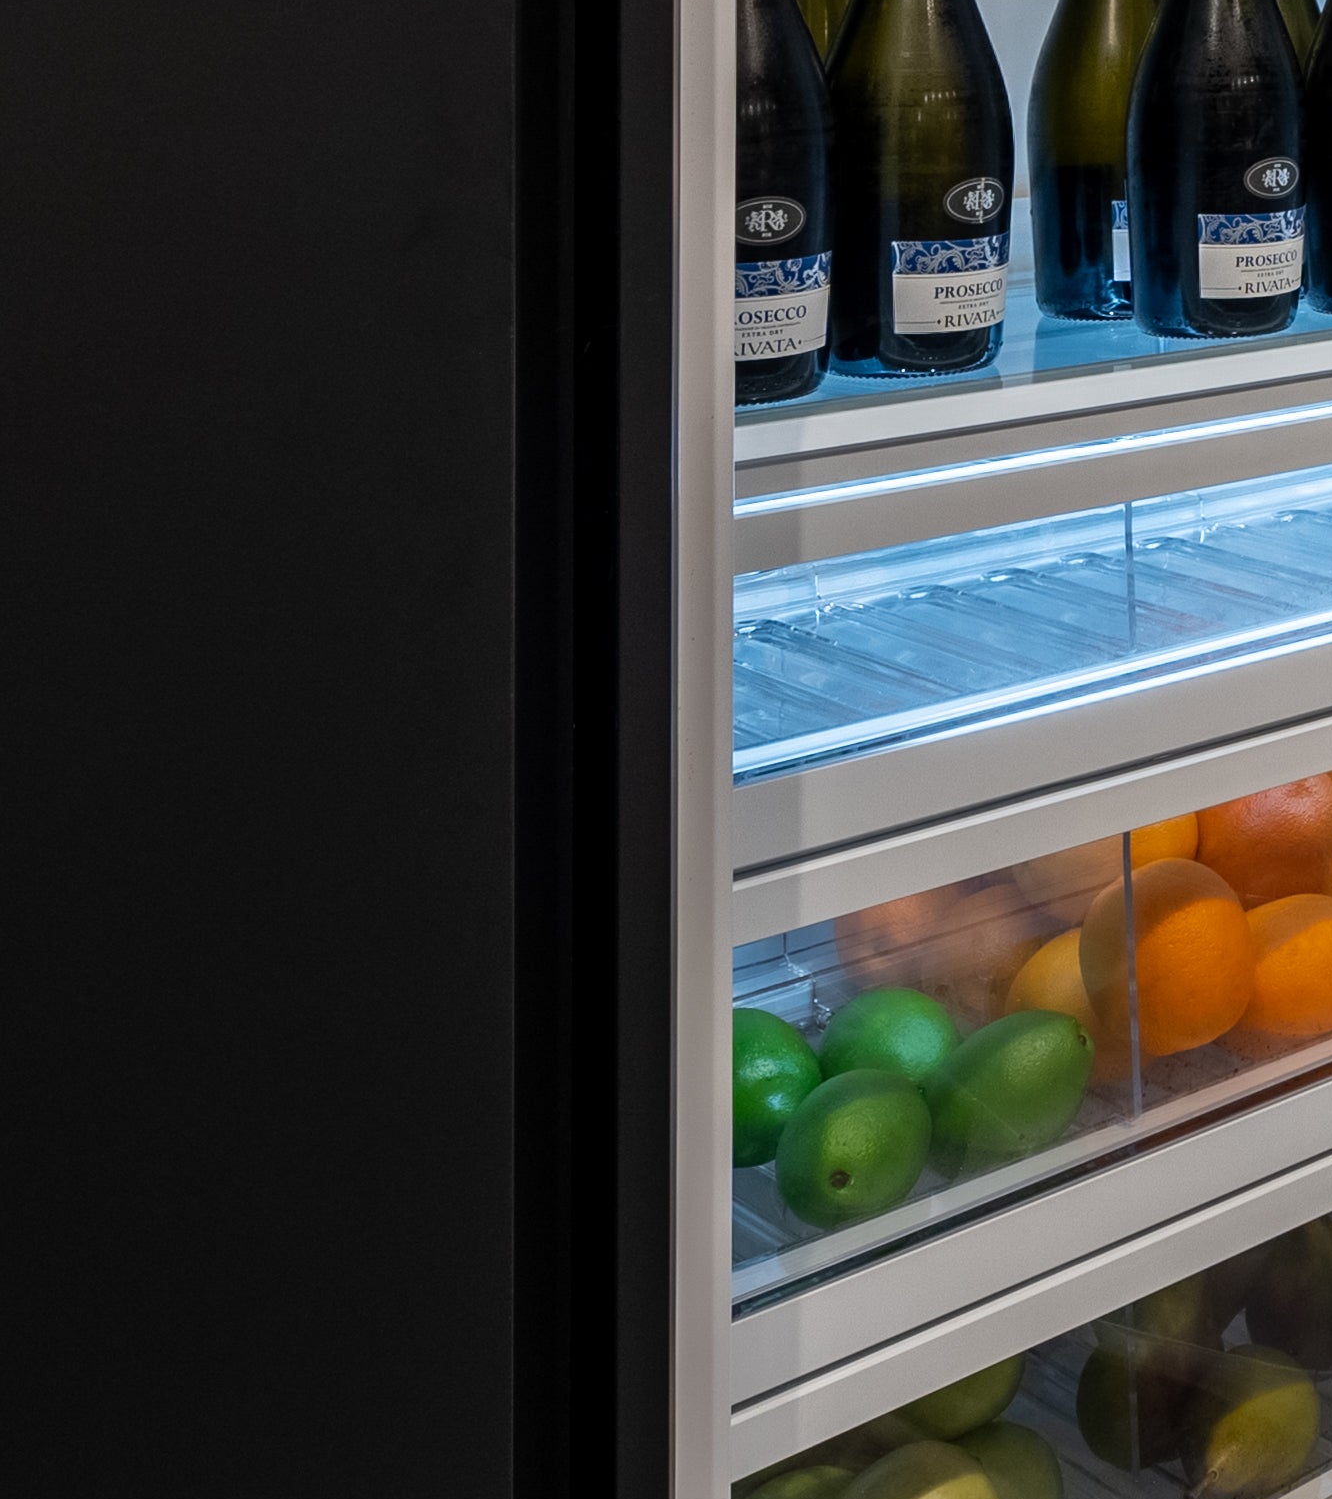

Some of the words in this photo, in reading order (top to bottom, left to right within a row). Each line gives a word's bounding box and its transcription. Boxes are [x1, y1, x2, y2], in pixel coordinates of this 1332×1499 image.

[1235, 249, 1298, 268] PROSECCO
[934, 278, 1003, 300] PROSECCO
[1244, 277, 1292, 294] RIVATA
[944, 308, 998, 329] RIVATA
[769, 328, 784, 337] DRY
[737, 337, 798, 357] IVATA
